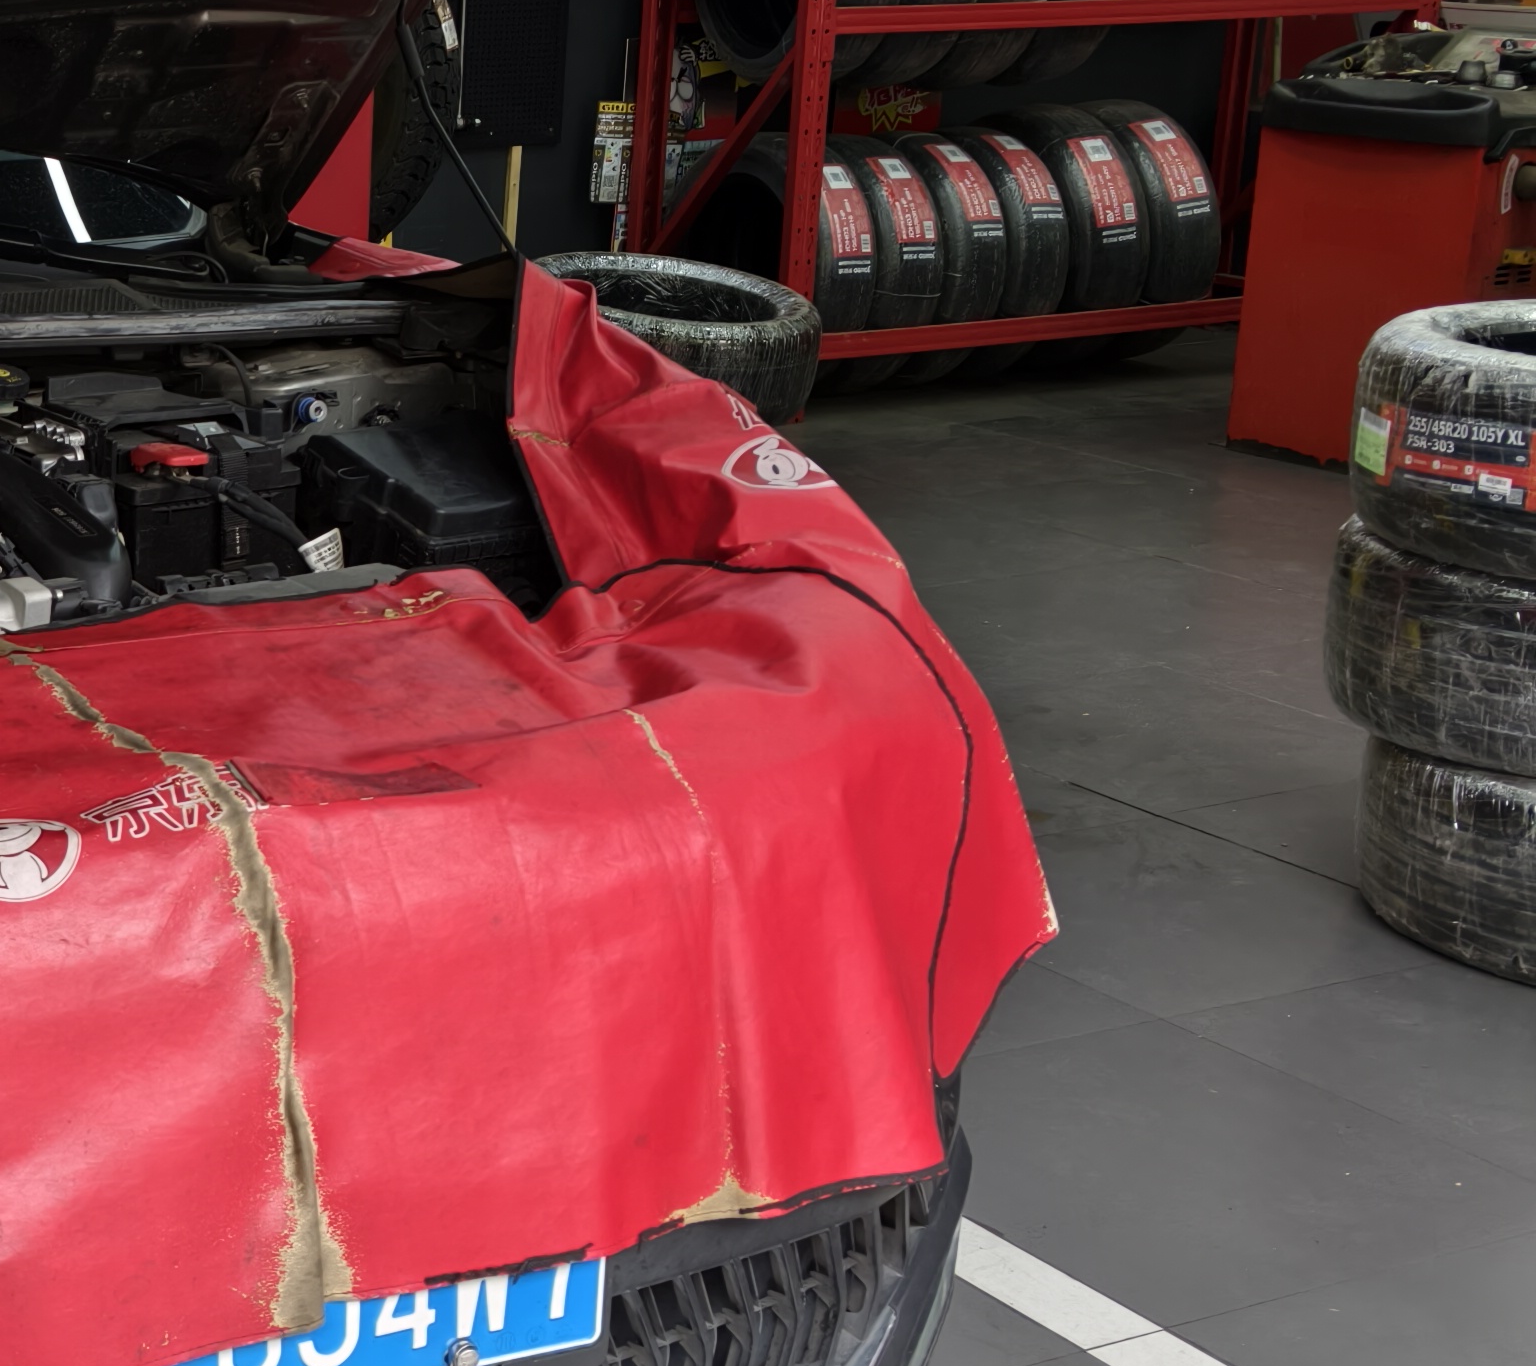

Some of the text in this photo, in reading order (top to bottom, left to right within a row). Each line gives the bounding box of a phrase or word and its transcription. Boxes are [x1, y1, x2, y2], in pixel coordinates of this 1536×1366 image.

[1408, 415, 1526, 446] 255/45R20 105Y XL
